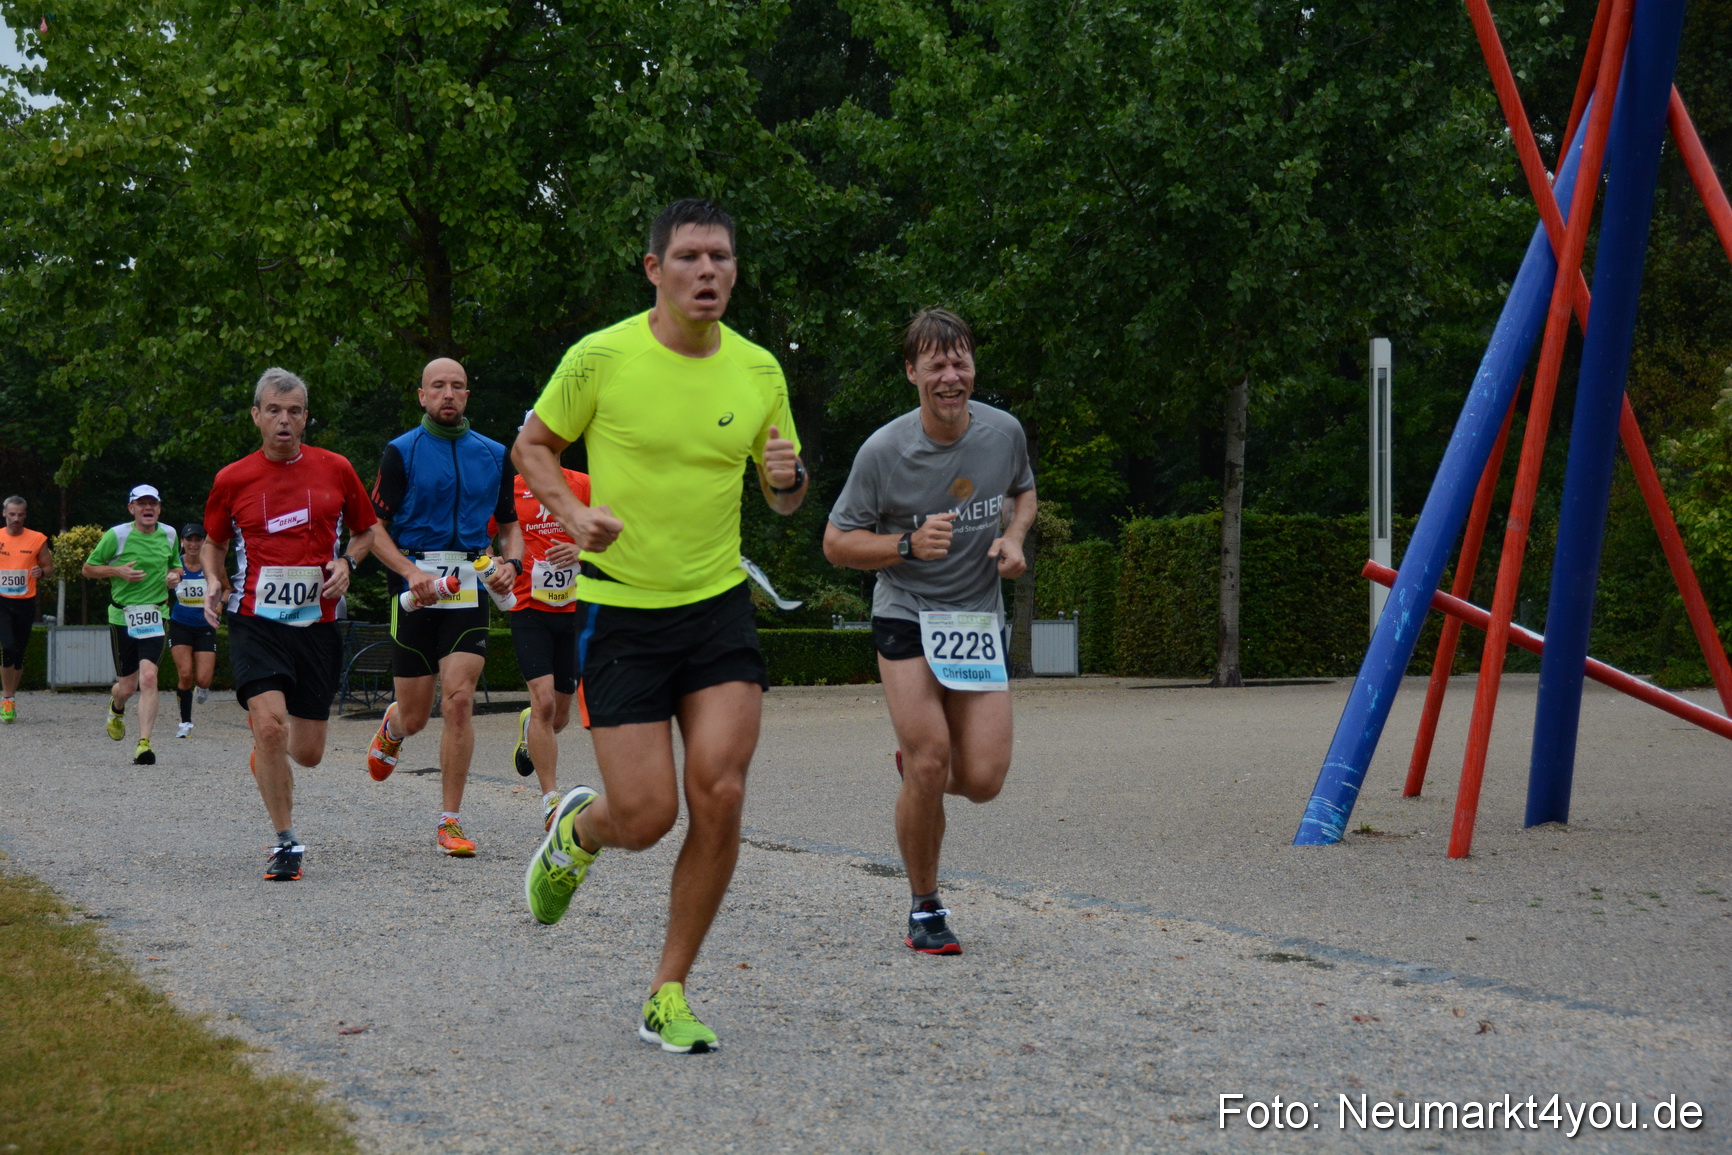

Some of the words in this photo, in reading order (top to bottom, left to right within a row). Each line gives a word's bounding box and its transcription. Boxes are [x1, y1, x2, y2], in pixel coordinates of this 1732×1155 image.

[279, 516, 298, 527] DEHN
[525, 521, 562, 533] funrunne
[538, 526, 565, 535] neuma
[288, 568, 321, 577] BOCK
[1, 575, 26, 586] 2500
[542, 569, 573, 588] 297
[183, 586, 204, 597] 133
[263, 582, 319, 606] 2404
[128, 611, 159, 627] 2590
[280, 610, 300, 621] Ernst
[931, 630, 997, 661] 2228
[942, 667, 992, 682] Christoph
